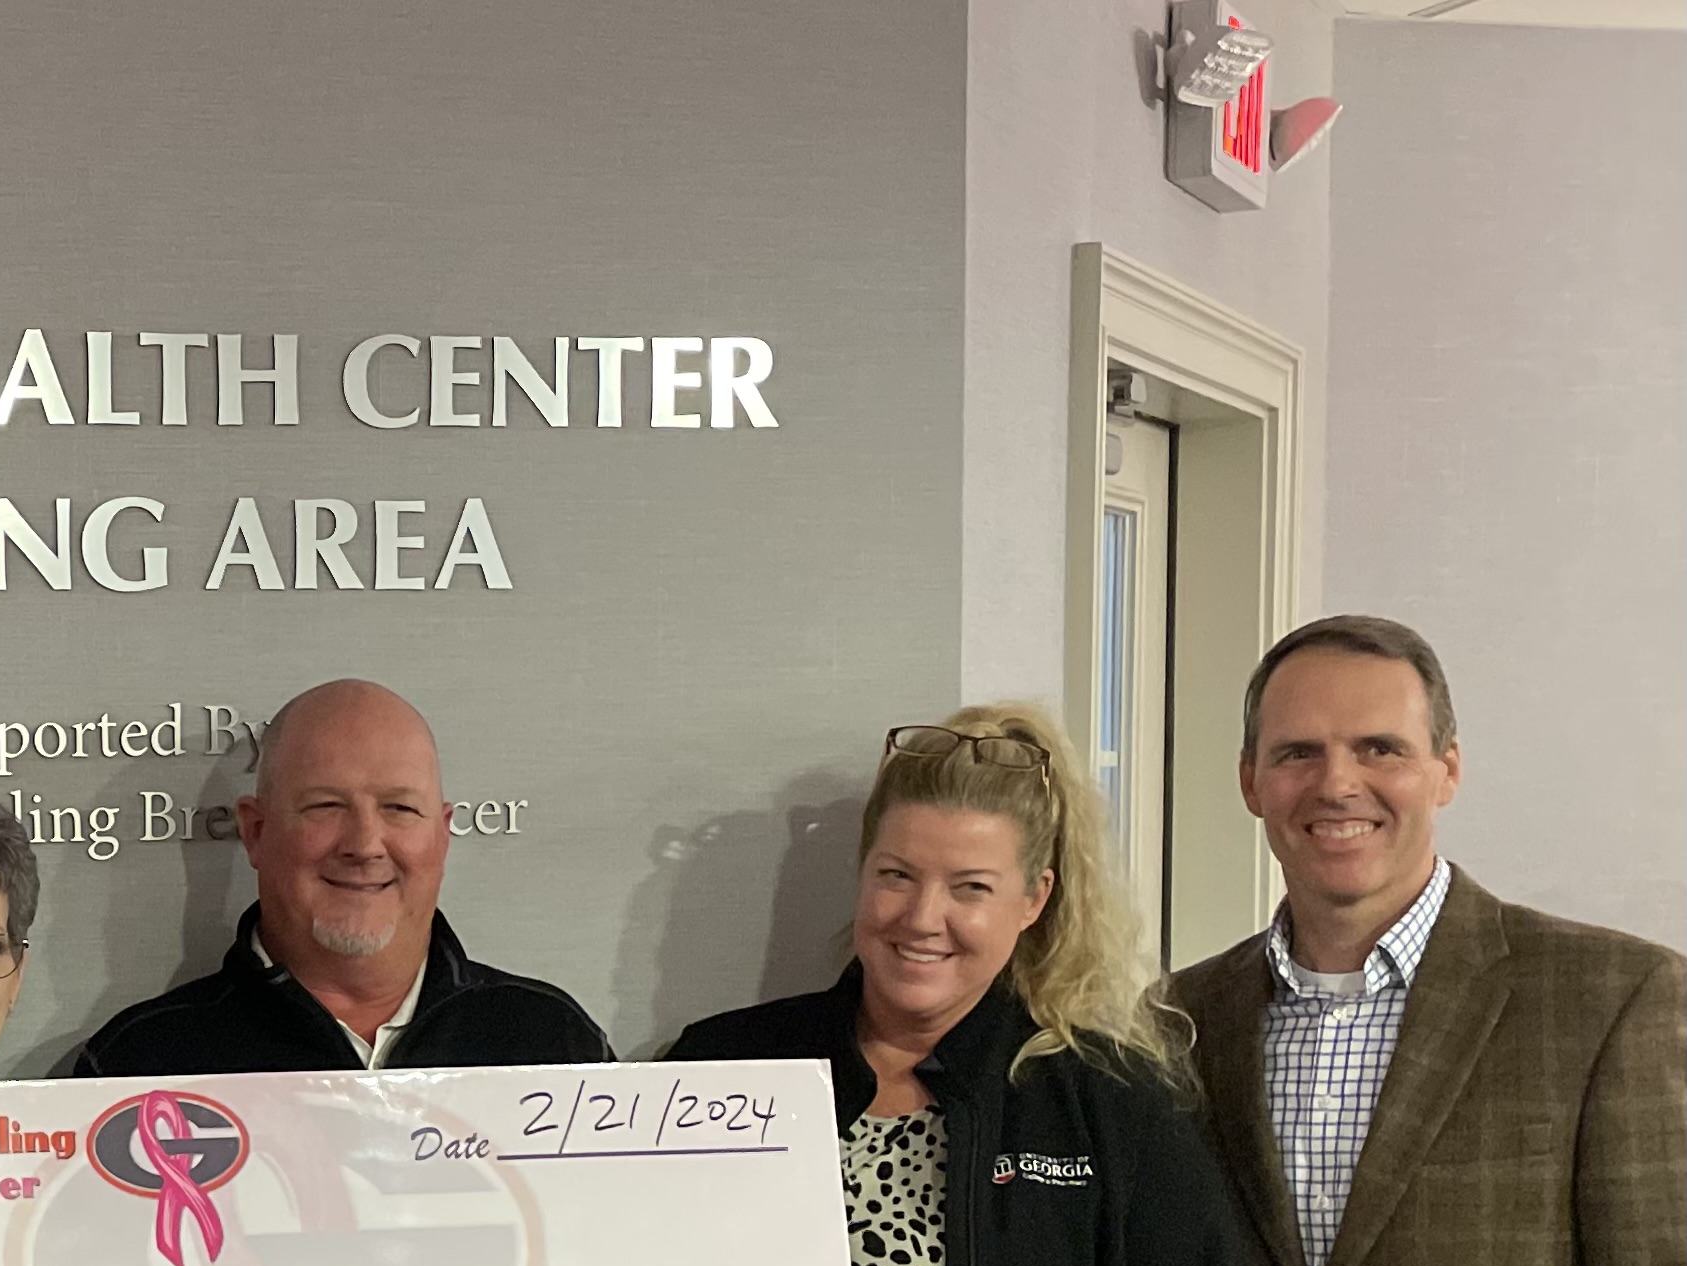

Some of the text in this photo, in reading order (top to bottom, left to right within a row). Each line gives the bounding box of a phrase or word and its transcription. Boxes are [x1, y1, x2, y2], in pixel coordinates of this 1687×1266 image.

[343, 334, 780, 428] CENTER
[205, 497, 513, 592] AREA
[140, 791, 234, 841] Bre
[449, 799, 529, 836] cer
[411, 1079, 776, 1161] Date 2/21/2024
[1019, 1159, 1093, 1178] GEORGIA
